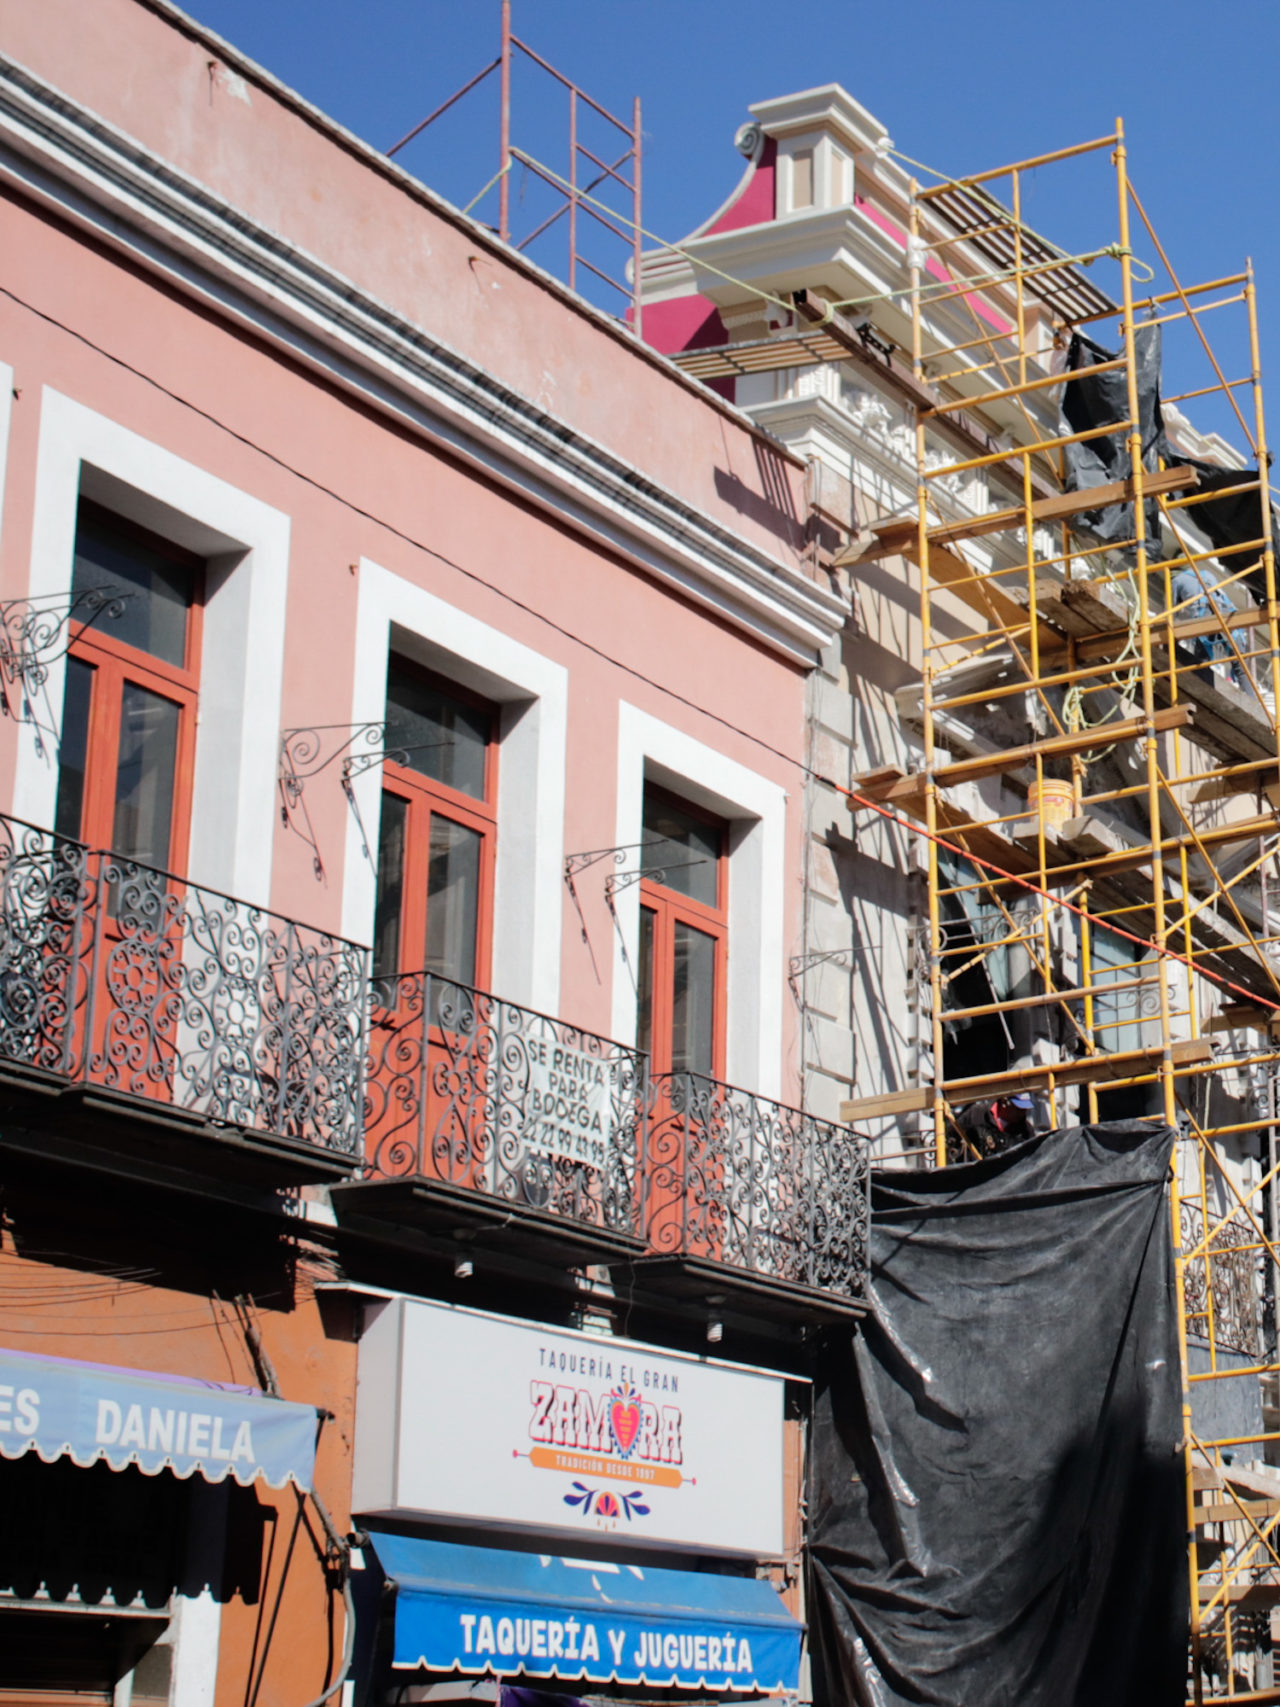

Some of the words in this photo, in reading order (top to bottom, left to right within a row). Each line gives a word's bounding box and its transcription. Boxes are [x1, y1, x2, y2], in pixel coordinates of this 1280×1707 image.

[528, 1039, 547, 1066] SE
[554, 1049, 605, 1086] RENTA
[549, 1072, 589, 1103] PARA
[533, 1089, 603, 1135] BODEGA
[539, 1348, 613, 1380] TAQUERÍA
[620, 1365, 636, 1385] EL
[644, 1370, 679, 1393] GRAN
[95, 1398, 256, 1464] DANIELA
[555, 1454, 604, 1473] TRADICIÓN
[606, 1463, 633, 1478] DESDE
[459, 1613, 600, 1661] TAQUERÍA
[608, 1629, 626, 1666] Y
[633, 1632, 754, 1673] JUGUERÍA
